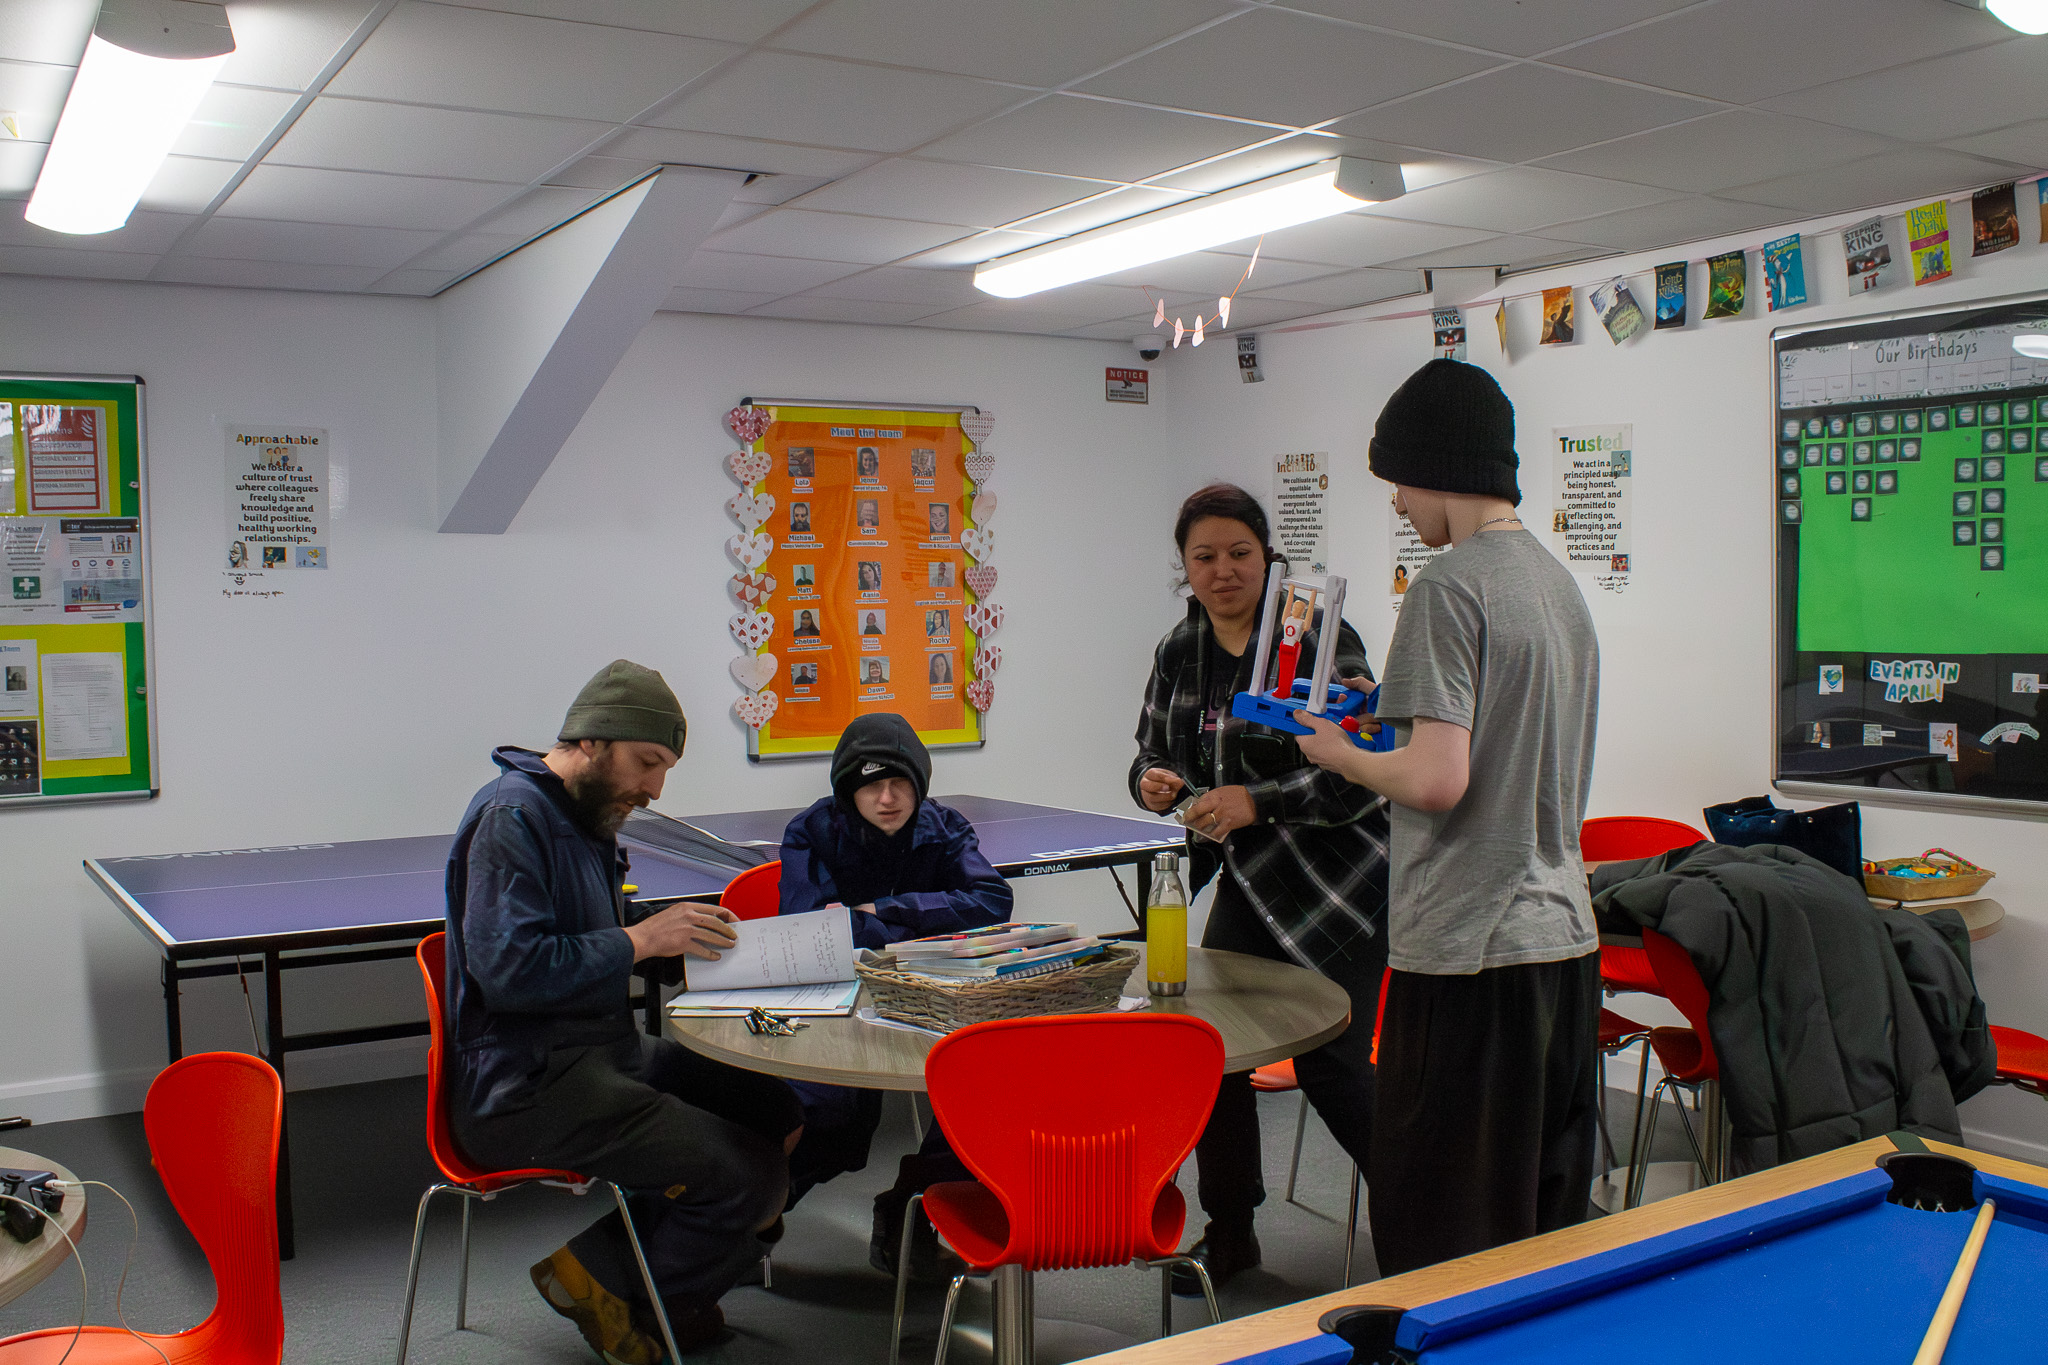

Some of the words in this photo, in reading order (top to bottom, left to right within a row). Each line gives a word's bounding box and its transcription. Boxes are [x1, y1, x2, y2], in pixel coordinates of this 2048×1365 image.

[1910, 201, 1943, 227] Roald
[1845, 221, 1881, 241] STEPHEN
[1913, 216, 1946, 238] Dahl
[1846, 230, 1883, 253] KING
[1864, 271, 1880, 290] IT
[1434, 315, 1461, 328] KING
[1238, 342, 1255, 352] KING
[1875, 345, 1900, 364] Our
[1907, 339, 1978, 362] Birthdays
[1444, 348, 1456, 359] IT
[1109, 369, 1144, 379] NOTICE
[830, 427, 855, 437] Meet
[858, 428, 875, 438] the
[878, 429, 903, 439] team
[236, 433, 319, 446] Approachable
[1559, 432, 1623, 453] Trusted
[251, 463, 267, 471] We
[268, 463, 295, 472] foster
[1572, 461, 1584, 469] We
[1585, 460, 1596, 468] act
[242, 473, 276, 482] culture
[278, 473, 289, 482] of
[289, 474, 313, 482] trust
[1563, 470, 1601, 481] principled
[235, 483, 266, 491] where
[268, 484, 319, 494] colleagues
[1567, 481, 1588, 490] being
[249, 494, 278, 503] freely
[279, 494, 306, 502] share
[1607, 490, 1622, 498] and
[241, 503, 295, 514] knowledge
[296, 505, 314, 513] and
[1567, 501, 1607, 509] committed
[243, 514, 269, 522] build
[1567, 512, 1603, 521] reflecting
[238, 524, 275, 534] healthy
[277, 524, 317, 535] working
[1277, 524, 1300, 532] challenge
[244, 534, 312, 544] relationships.
[1565, 532, 1603, 542] improving
[1399, 546, 1432, 554] compassion
[1567, 543, 1600, 552] practices
[1569, 553, 1612, 561] behaviours.
[1871, 662, 1933, 681] EVENTS
[1940, 663, 1958, 680] IN
[1888, 678, 1941, 701] APRIL!
[1030, 837, 1187, 859] DONNA
[1024, 863, 1071, 876] DONNAY
